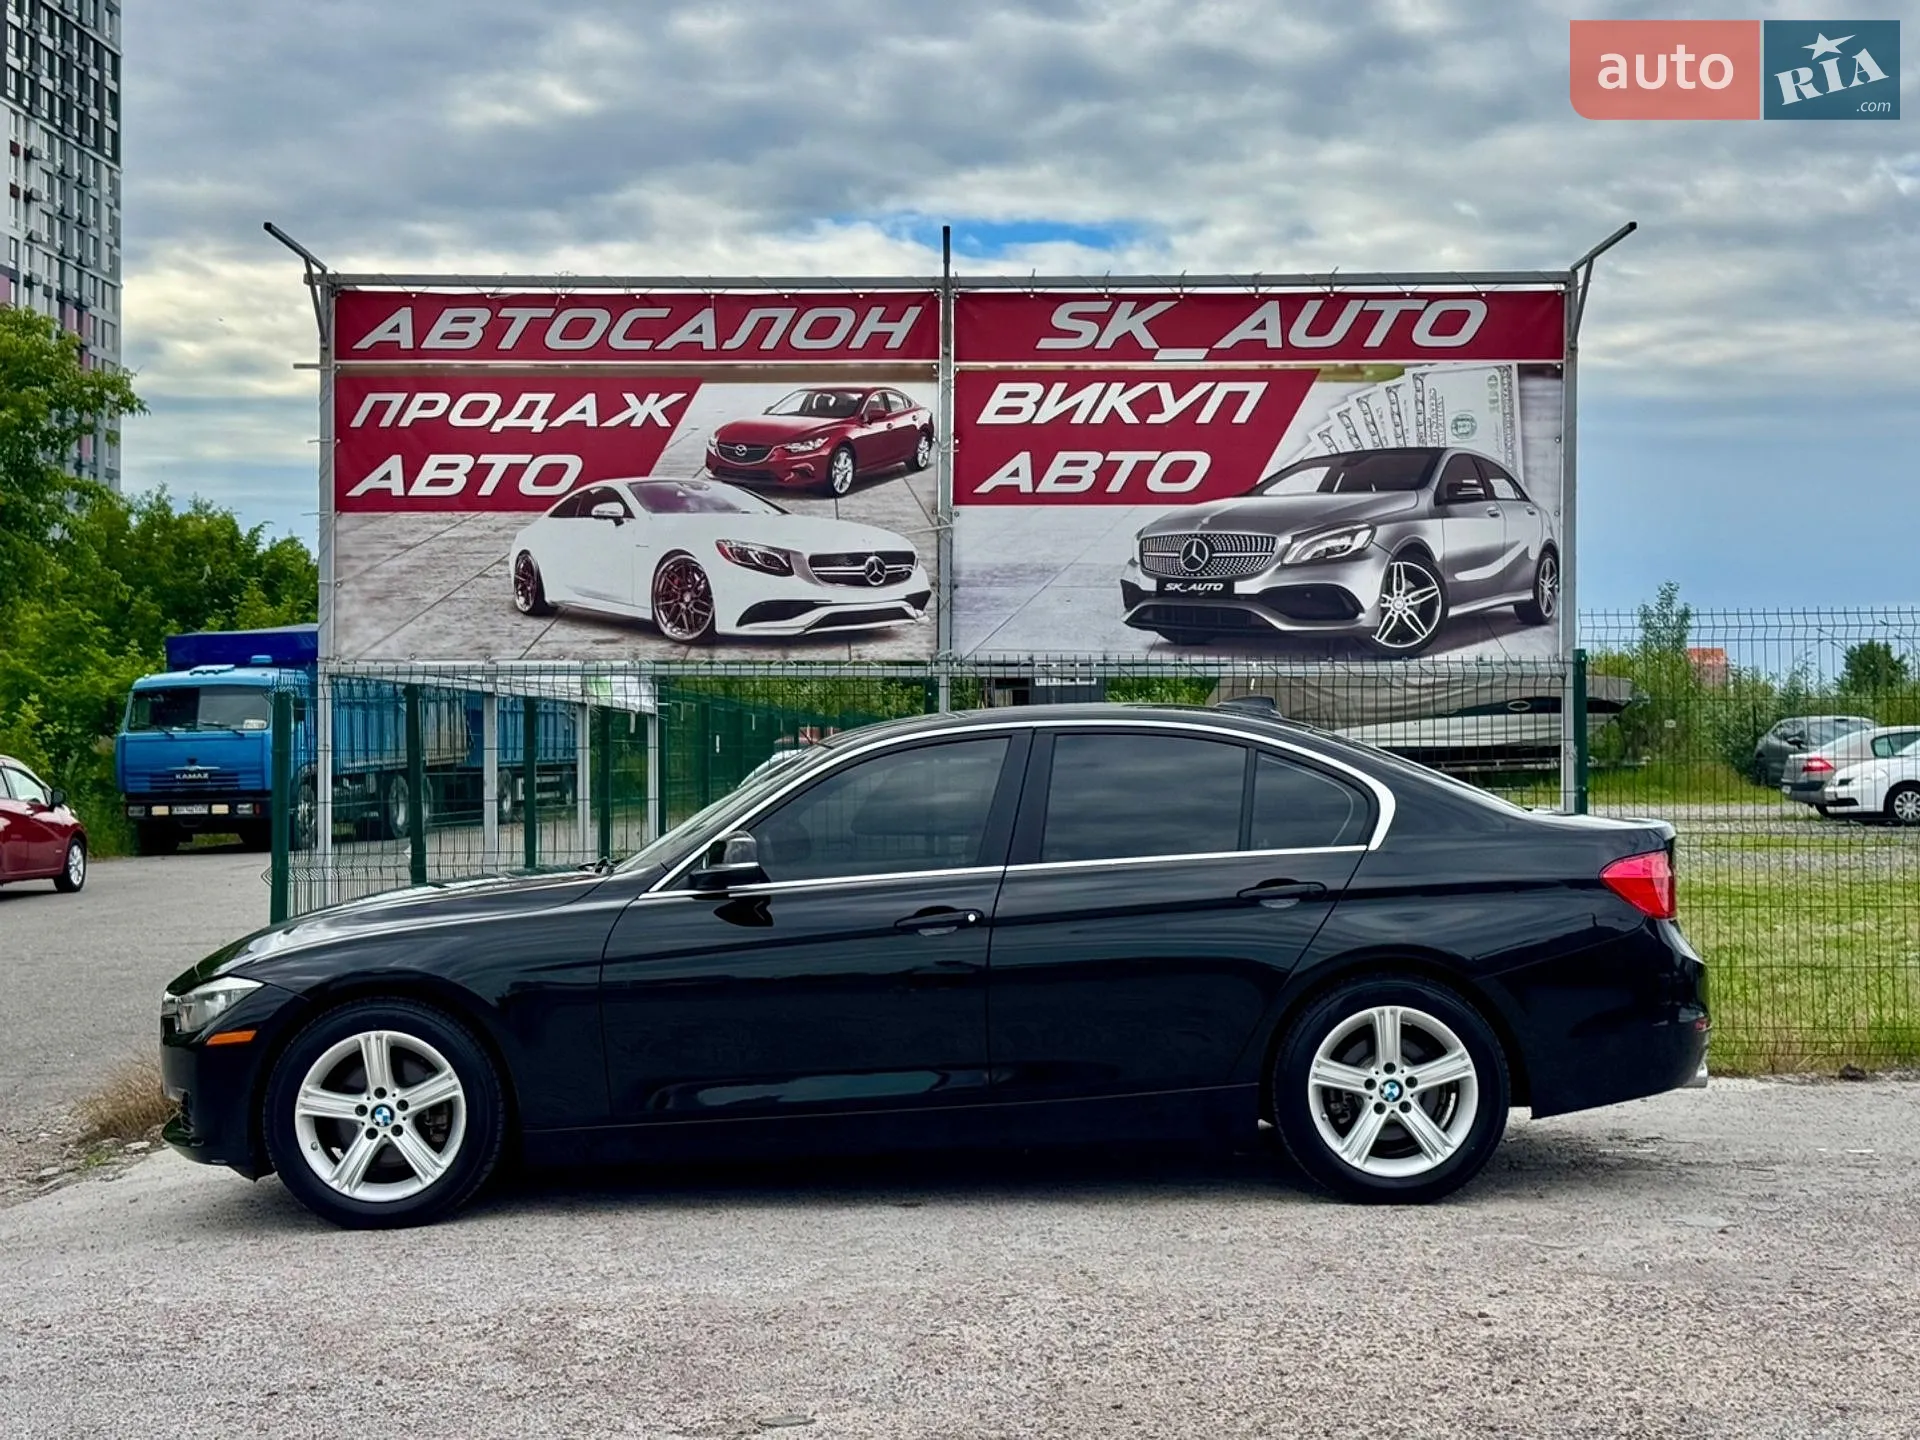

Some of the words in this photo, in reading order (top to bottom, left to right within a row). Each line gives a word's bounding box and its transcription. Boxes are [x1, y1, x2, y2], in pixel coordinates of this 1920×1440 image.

[353, 306, 922, 351] АВТОСАЛОН
[1036, 298, 1488, 361] SK_AUTO
[350, 392, 687, 433] ПРОДАЖ
[976, 381, 1268, 425] ВИКУП
[347, 454, 582, 498] АВТО
[973, 450, 1212, 494] АВТО
[1164, 582, 1224, 592] SK_AUTO
